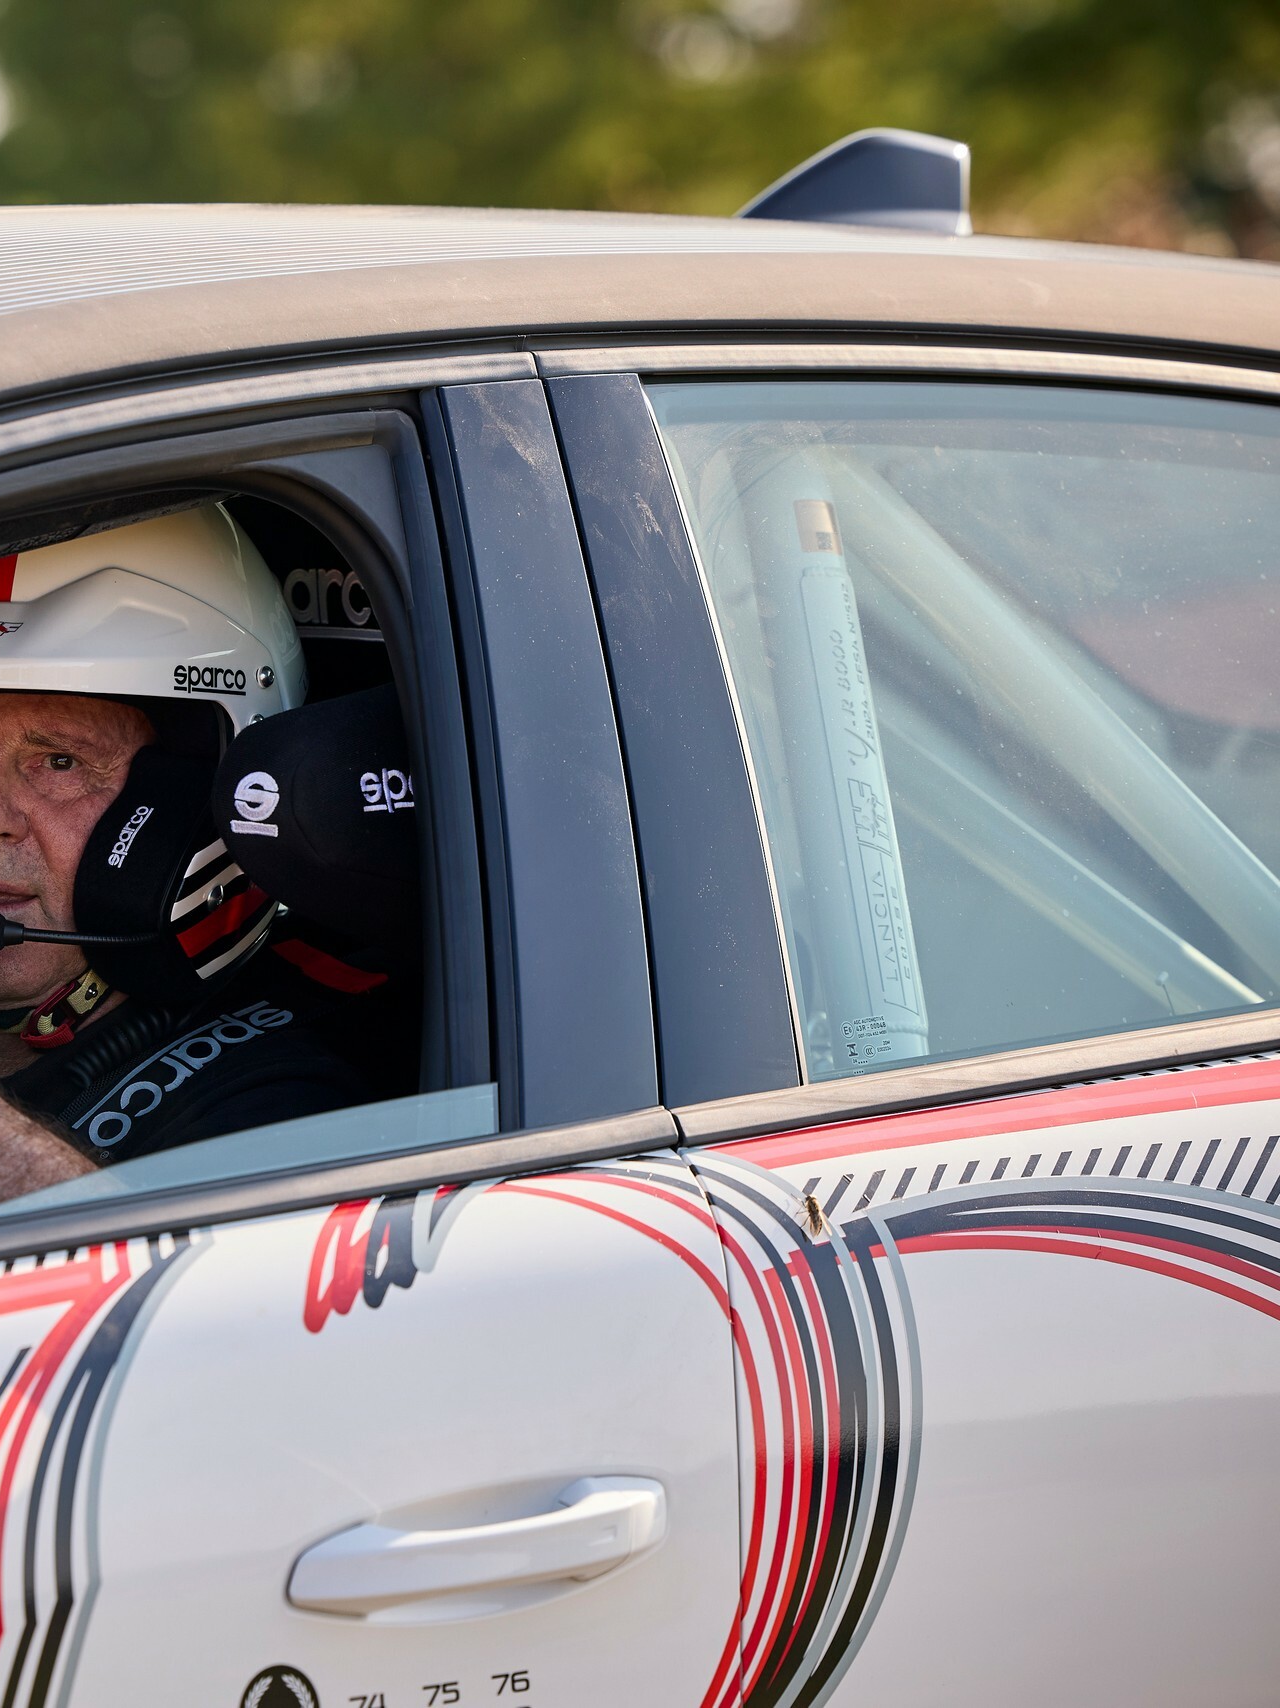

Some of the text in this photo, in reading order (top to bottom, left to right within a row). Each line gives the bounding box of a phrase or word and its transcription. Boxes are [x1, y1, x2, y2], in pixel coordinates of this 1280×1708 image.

[284, 568, 372, 626] arc
[173, 664, 246, 696] sparco
[107, 806, 154, 868] sparco
[872, 871, 898, 982] LANCIA
[87, 1002, 295, 1147] sparco
[422, 1681, 461, 1708] 75
[491, 1670, 530, 1696] 76
